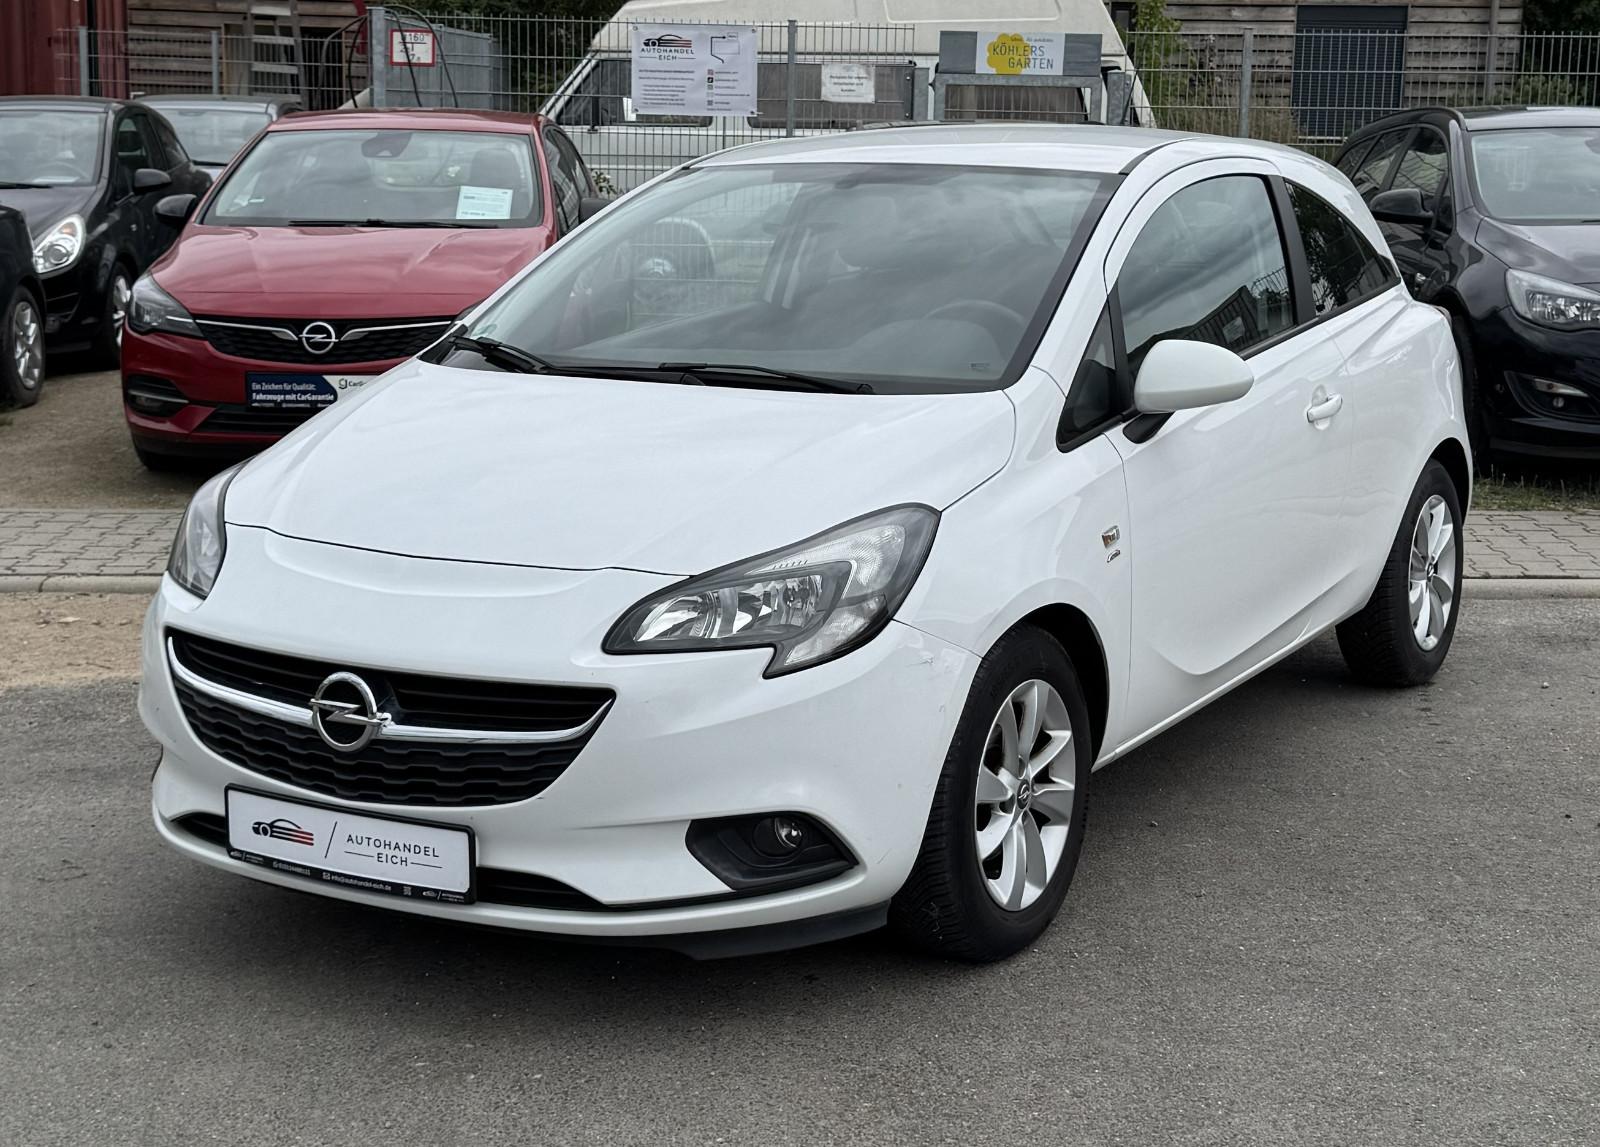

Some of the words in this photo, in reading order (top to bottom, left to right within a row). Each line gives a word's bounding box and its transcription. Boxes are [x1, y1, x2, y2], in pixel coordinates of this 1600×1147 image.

[640, 47, 695, 55] AUTOHANDEL
[992, 42, 1045, 57] KÖHLERS
[1008, 56, 1054, 70] GARTEN
[251, 382, 261, 390] Ein
[262, 382, 283, 391] Zeichen
[283, 382, 291, 391] für
[252, 393, 284, 402] Fahrzeuge
[285, 393, 297, 401] mit
[297, 392, 334, 401] CarGarantie
[346, 834, 440, 858] AUTOHANDEL
[377, 852, 408, 867] EICH
